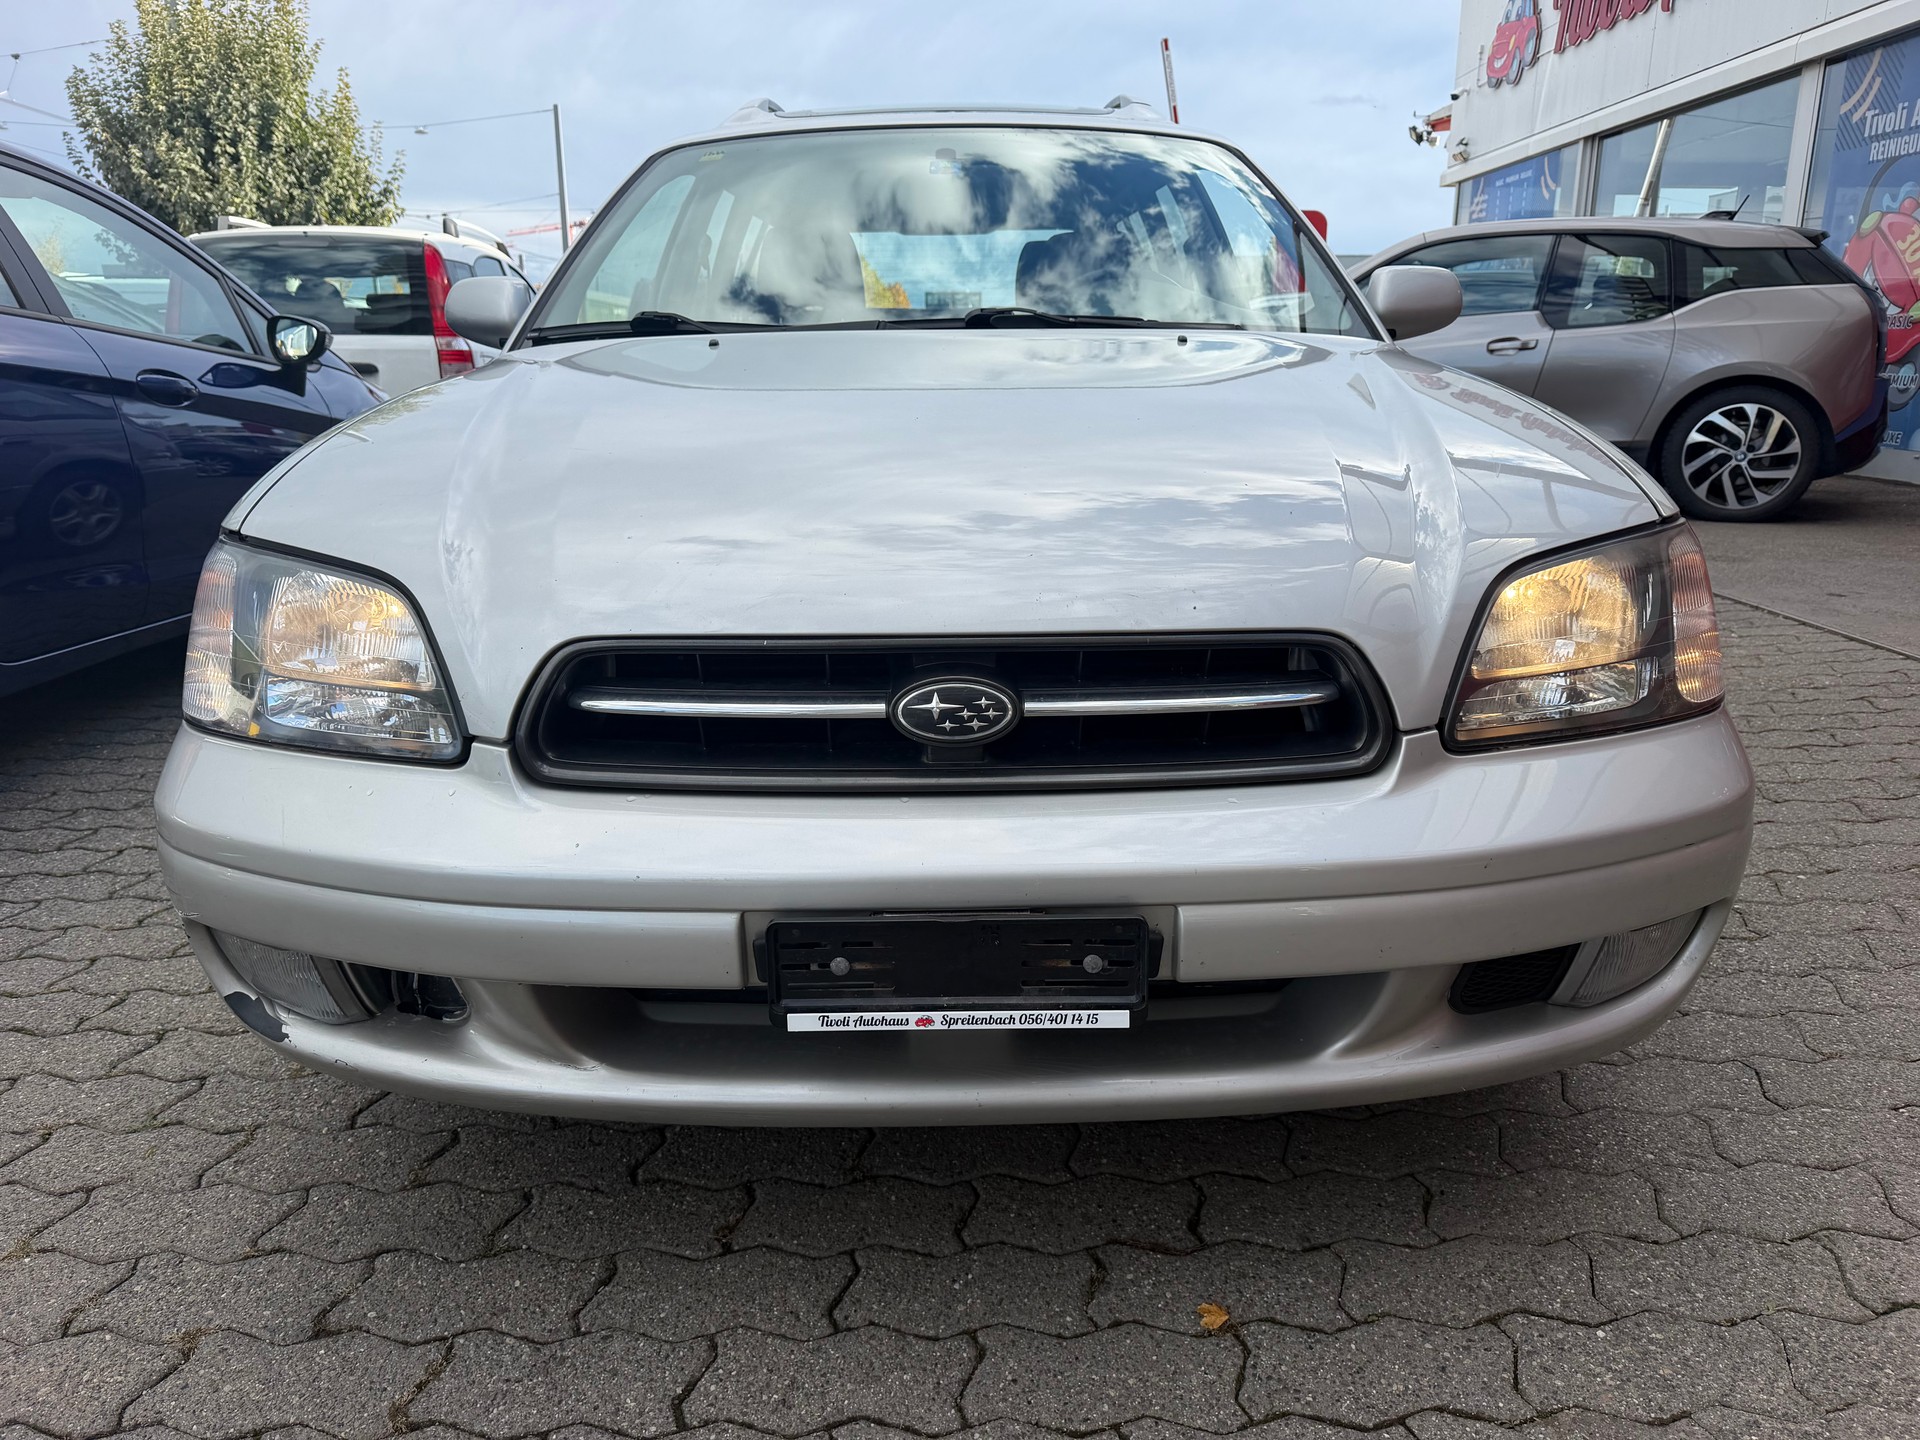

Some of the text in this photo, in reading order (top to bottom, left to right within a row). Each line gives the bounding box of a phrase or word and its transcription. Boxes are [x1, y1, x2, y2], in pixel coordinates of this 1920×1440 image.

[1864, 101, 1909, 137] Tivoli
[1889, 373, 1919, 388] MIUM
[818, 1012, 1099, 1029] Tivoli Autohaus Spreitenbach 056/401 14 15
